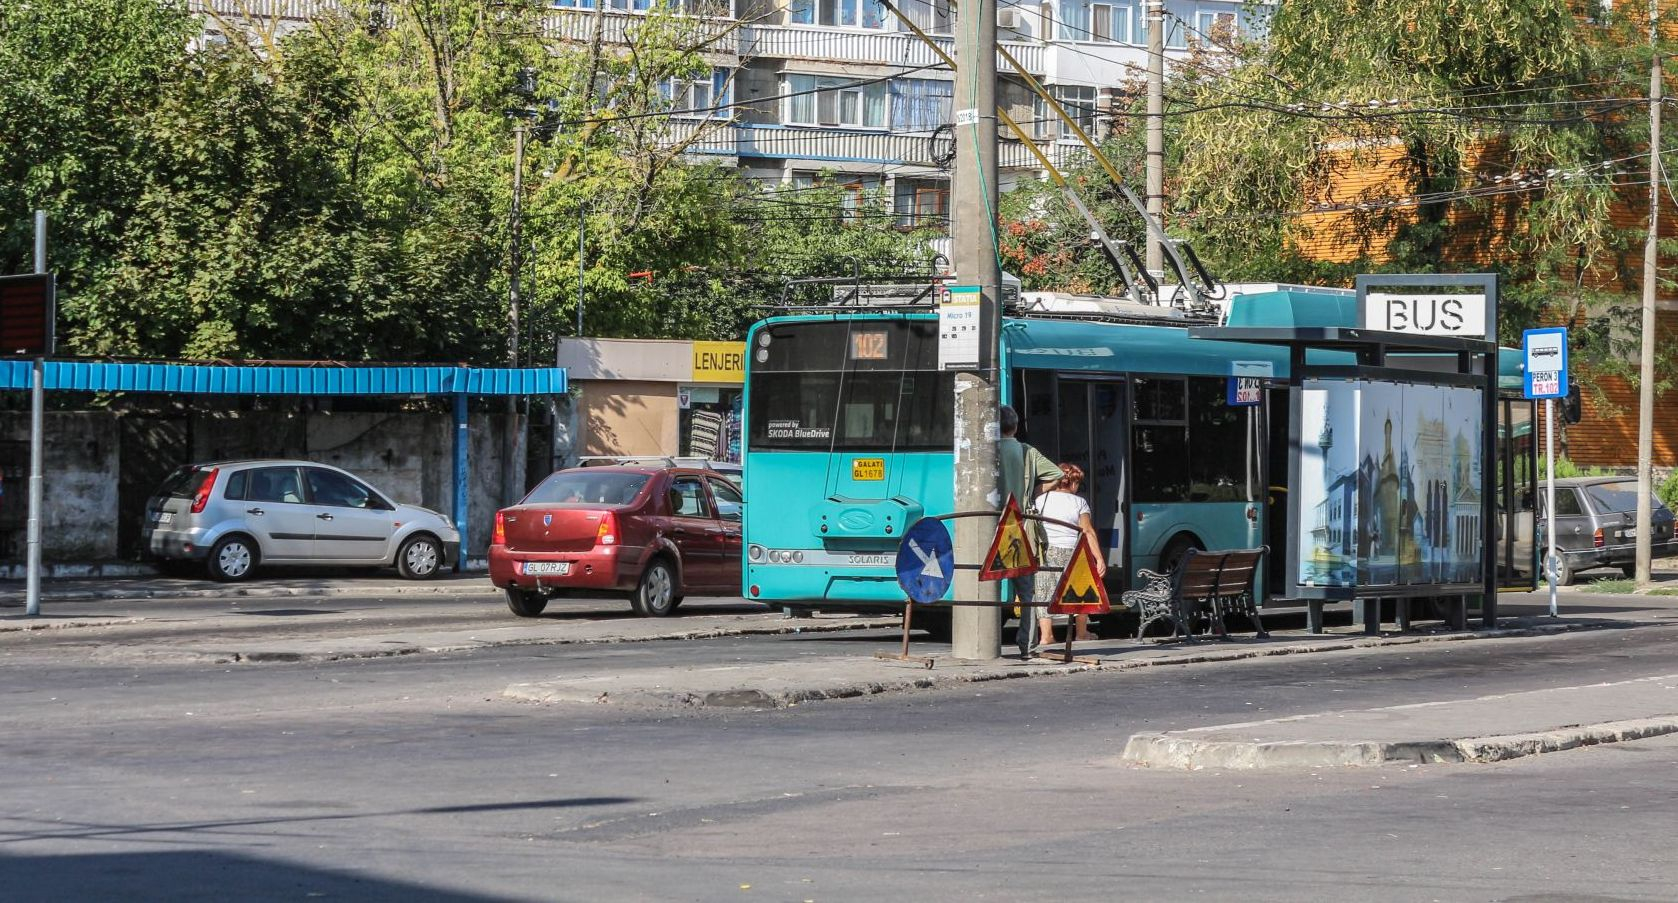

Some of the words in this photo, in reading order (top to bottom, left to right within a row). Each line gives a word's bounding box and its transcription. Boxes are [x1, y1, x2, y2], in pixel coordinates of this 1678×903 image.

[1386, 299, 1464, 331] BUS
[855, 333, 885, 358] 102
[1532, 372, 1552, 382] PERON
[1554, 371, 1558, 381] 3
[1534, 383, 1558, 394] TR.102
[768, 421, 792, 430] powered
[792, 421, 800, 430] by
[768, 429, 794, 438] SKODA
[794, 429, 830, 438] BlueDrive
[854, 470, 864, 478] GL
[864, 470, 883, 478] 1678
[848, 555, 889, 564] SOLARIS
[527, 563, 538, 572] GL
